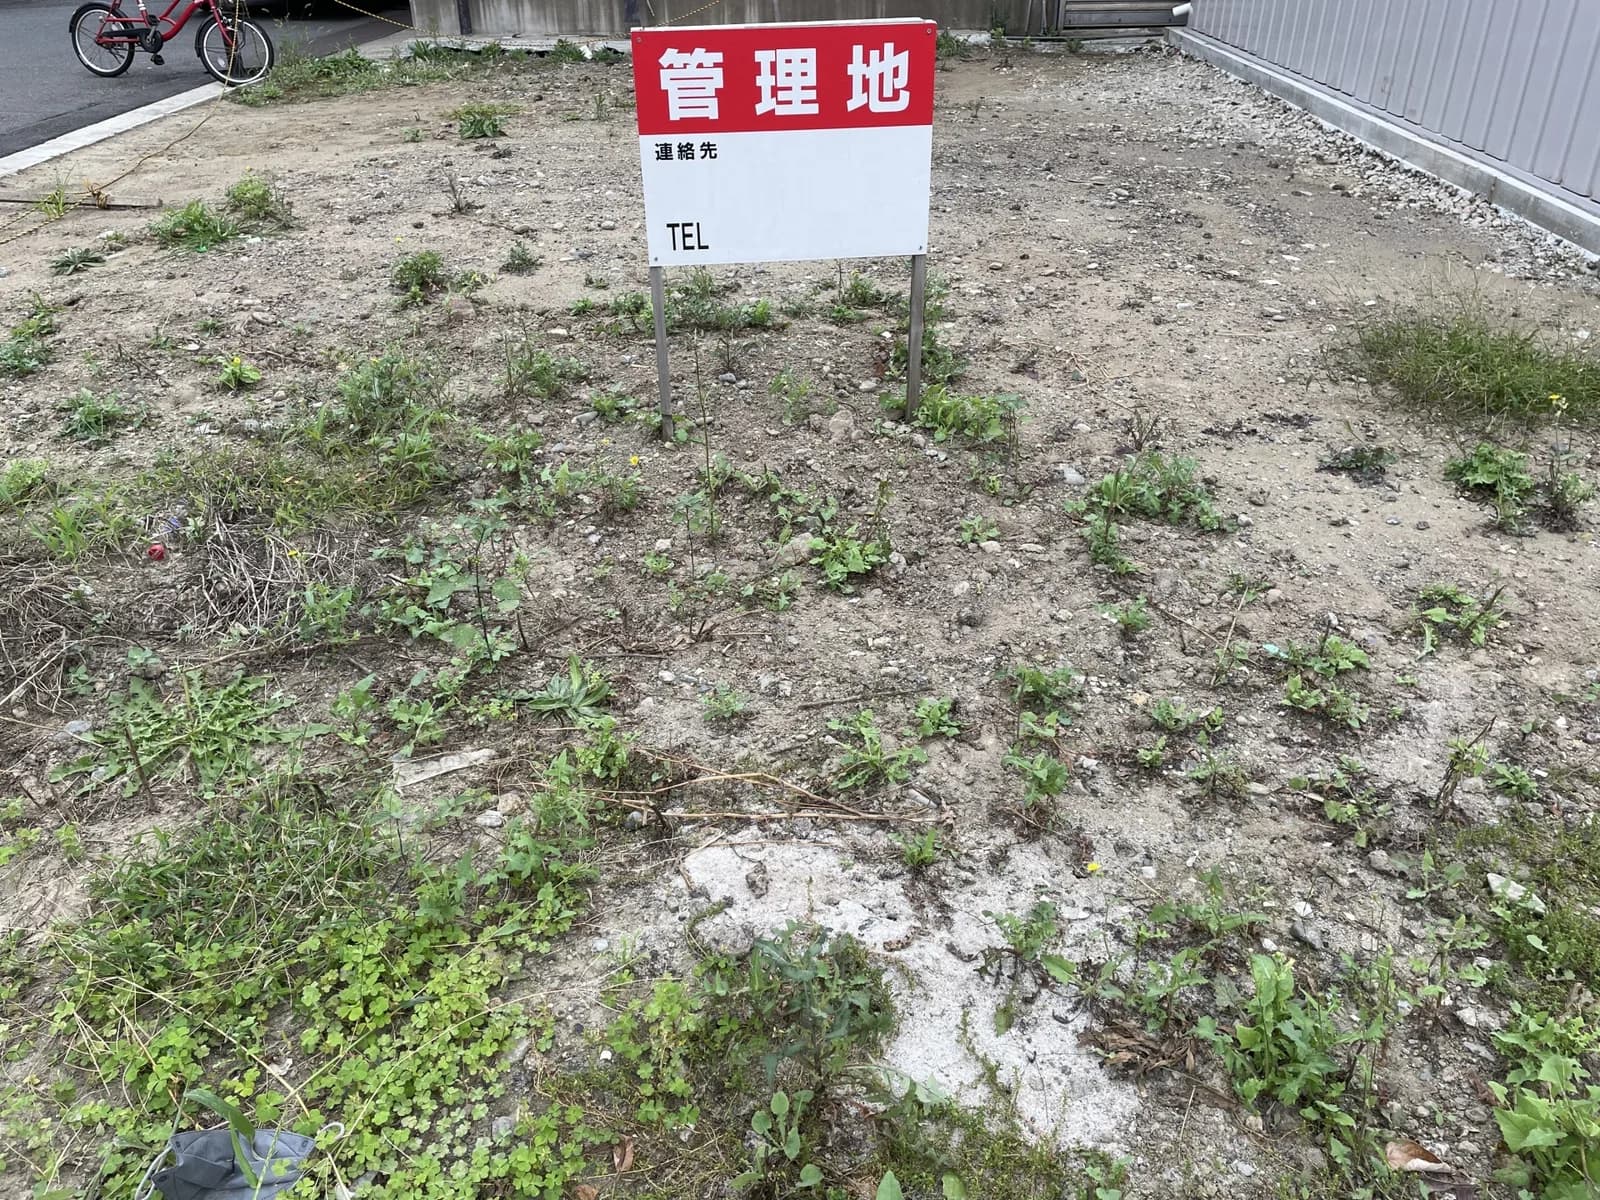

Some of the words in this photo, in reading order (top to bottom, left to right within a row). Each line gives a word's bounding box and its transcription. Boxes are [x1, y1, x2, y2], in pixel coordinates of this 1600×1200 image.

[658, 42, 910, 120] 管理地
[655, 142, 718, 160] 連絡先
[666, 222, 709, 251] TEL
